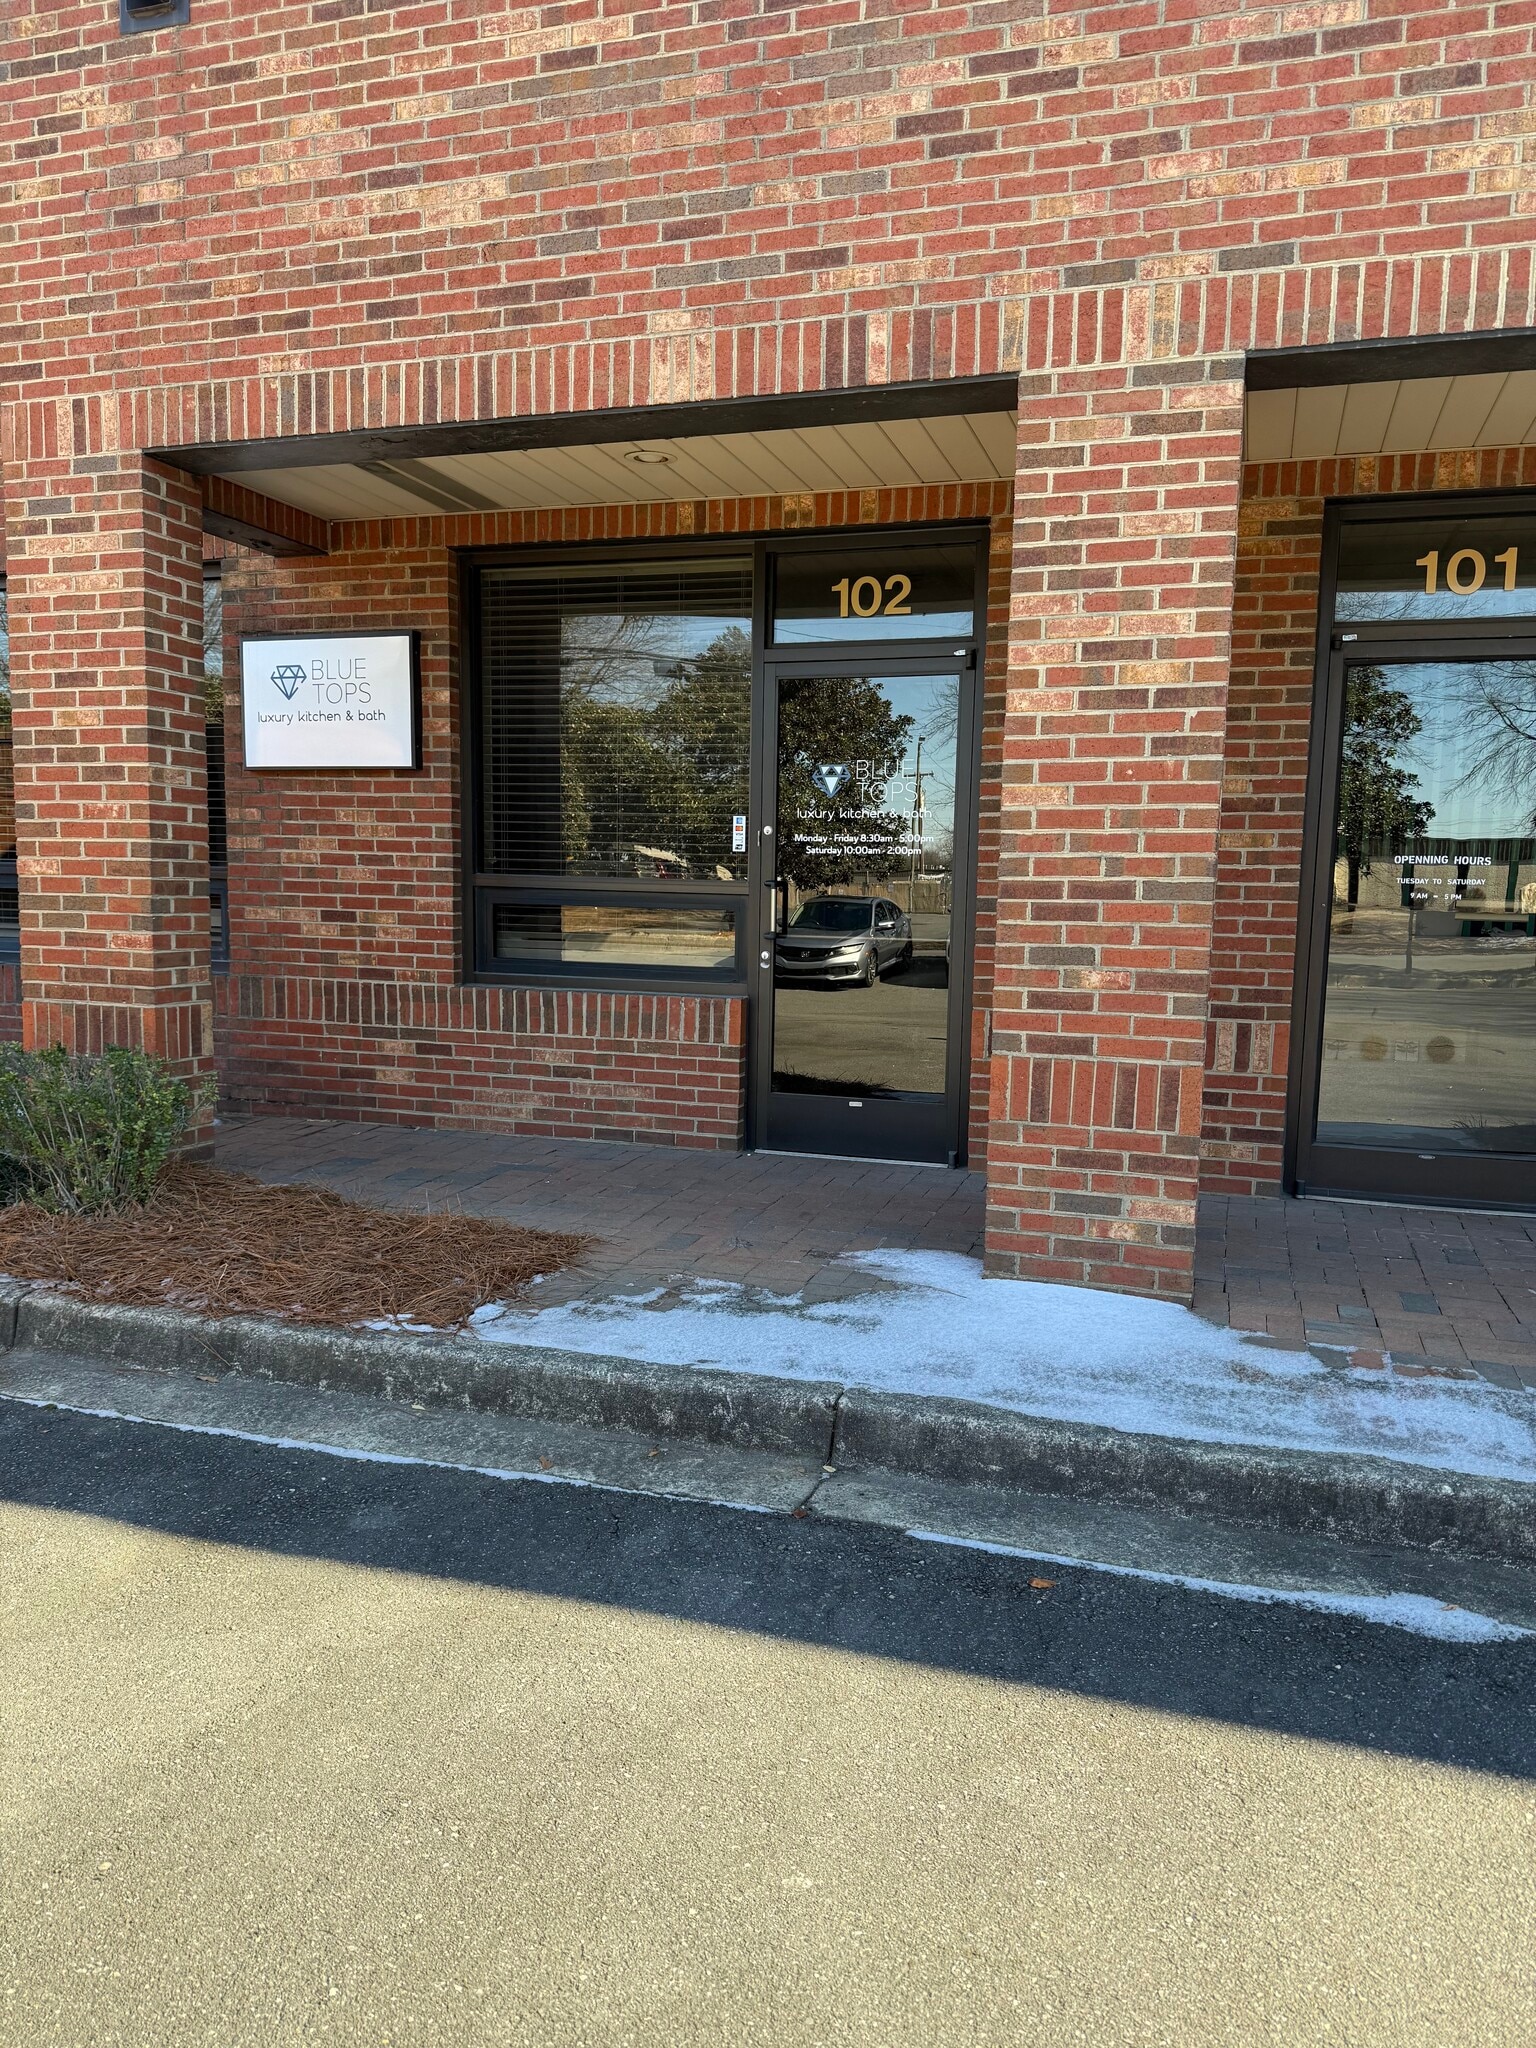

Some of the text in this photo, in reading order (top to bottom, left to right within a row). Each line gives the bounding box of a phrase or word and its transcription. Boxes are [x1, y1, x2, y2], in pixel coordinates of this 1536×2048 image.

[1415, 546, 1519, 596] 101
[831, 573, 912, 618] 102
[311, 657, 367, 681] BLUE
[311, 681, 372, 705] TOPS
[257, 709, 386, 726] luxury kitchen & bath
[855, 758, 915, 780] BLUE
[855, 781, 919, 803] TOPS
[796, 807, 933, 822] luxury kitchen & bath
[794, 833, 828, 844] Monday
[833, 833, 859, 844] Friday
[860, 833, 893, 843] 8:30am
[899, 833, 934, 844] 5:00pm
[805, 845, 842, 856] Saturday
[843, 845, 881, 855] 10:00am
[887, 845, 922, 856] 2:00pm
[1393, 855, 1492, 866] OPENNING HOURS
[1396, 877, 1430, 885] TUESDAY
